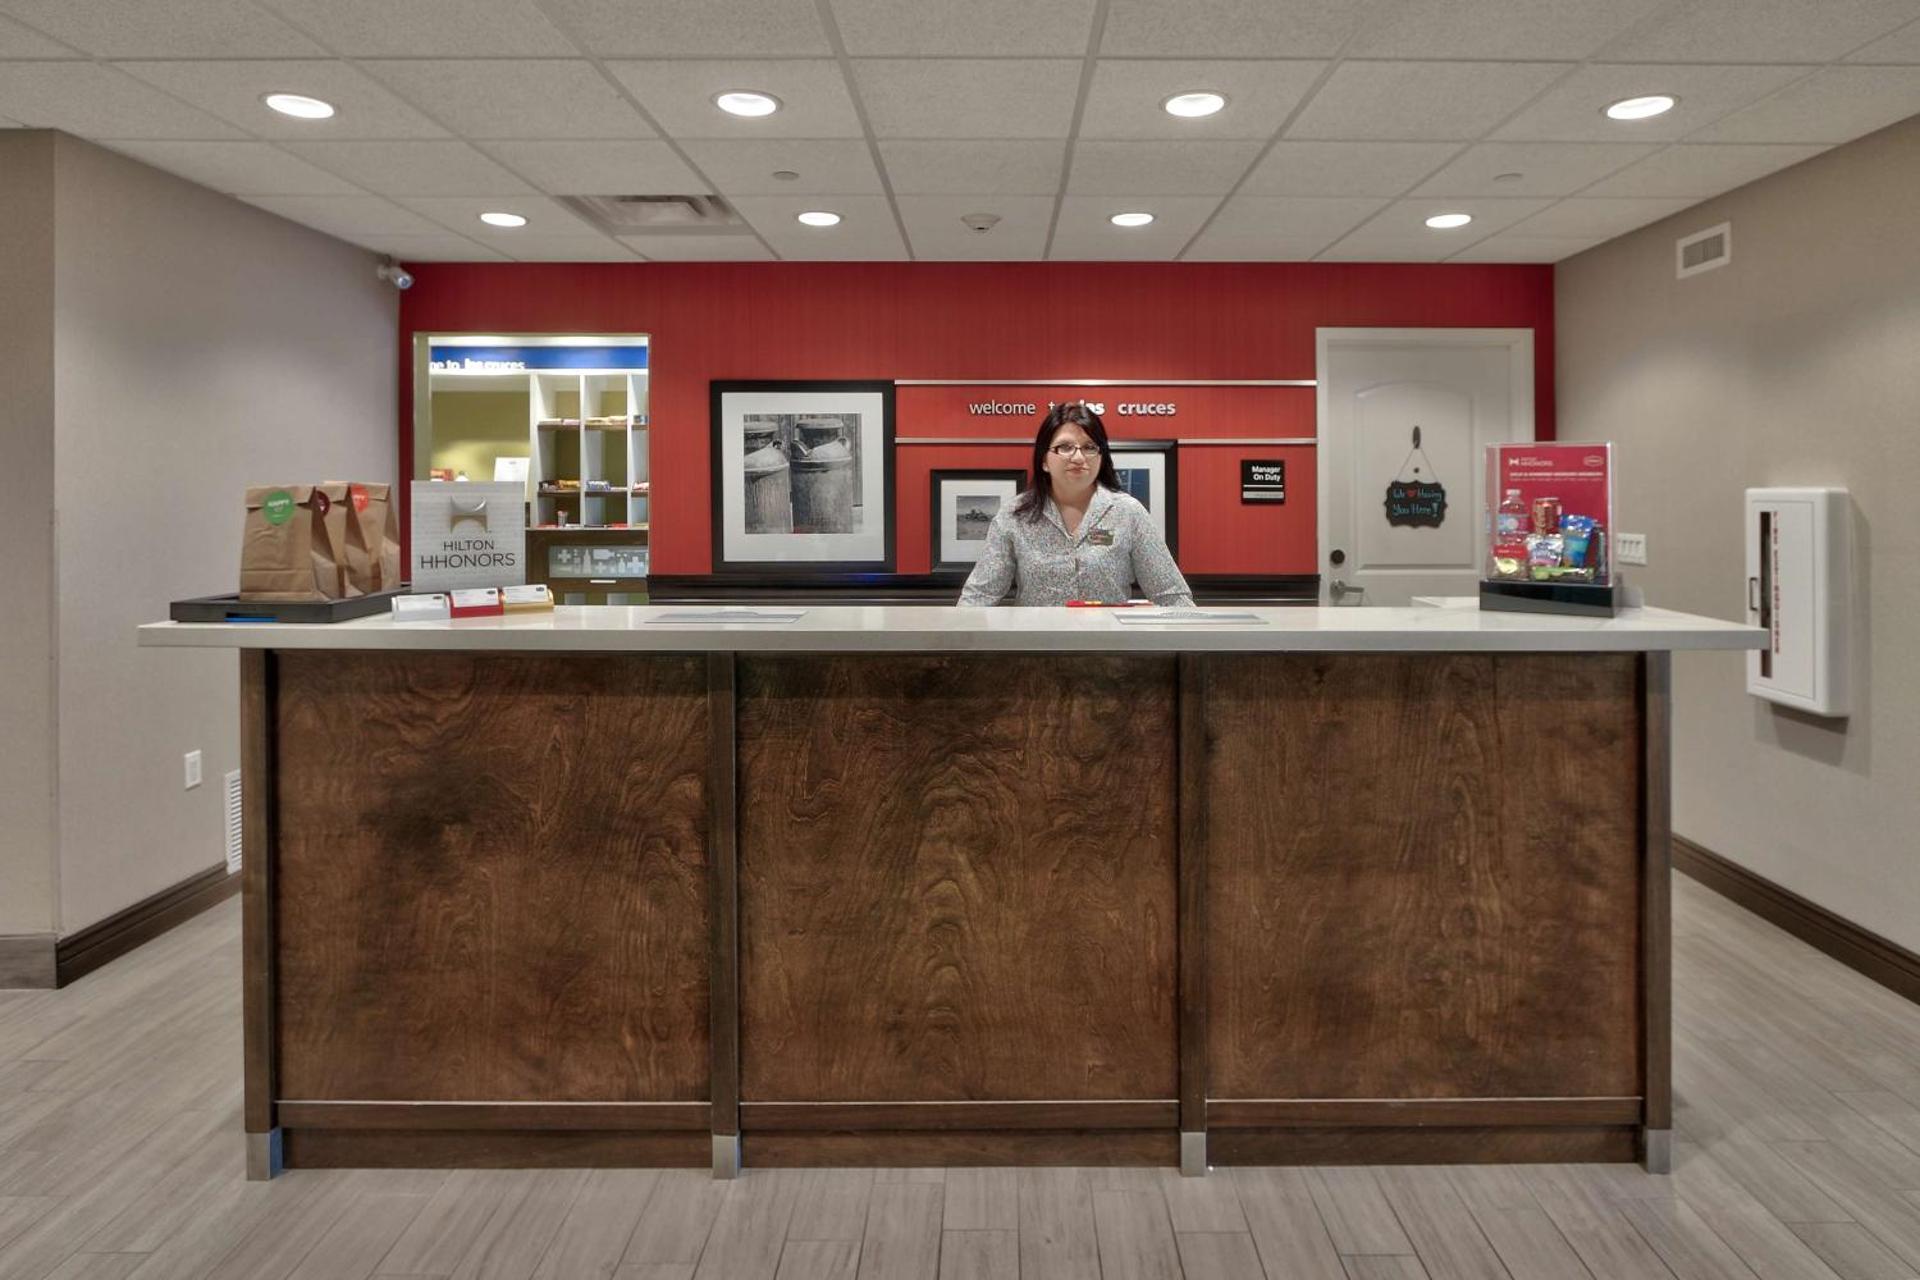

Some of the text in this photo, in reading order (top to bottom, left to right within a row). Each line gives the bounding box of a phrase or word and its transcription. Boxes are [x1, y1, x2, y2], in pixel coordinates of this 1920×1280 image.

[969, 400, 1036, 415] welcome
[1117, 401, 1176, 415] cruces
[1251, 465, 1281, 475] Manager
[1253, 473, 1281, 482] On Duty
[443, 540, 494, 551] HILTON
[420, 552, 516, 569] HHONORS
